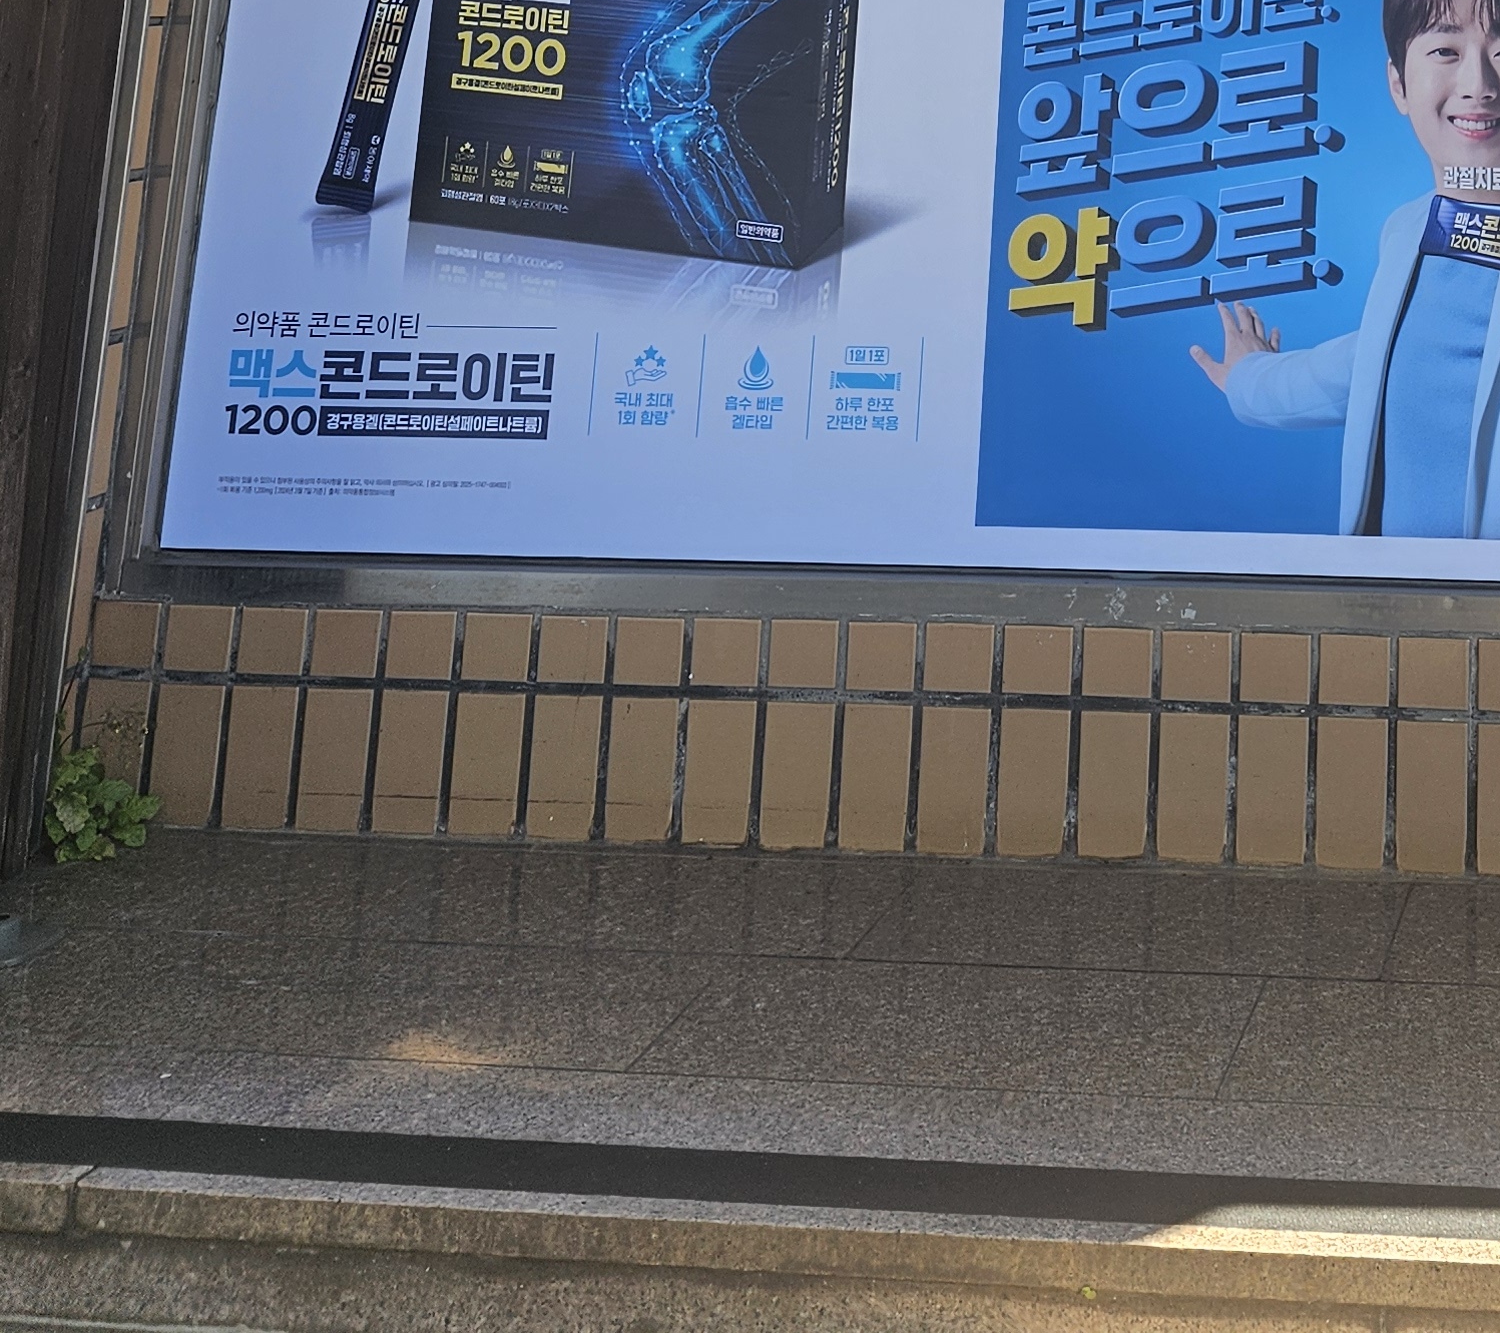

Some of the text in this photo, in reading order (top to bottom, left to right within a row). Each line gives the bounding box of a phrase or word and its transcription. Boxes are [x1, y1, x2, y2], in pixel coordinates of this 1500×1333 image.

[458, 0, 570, 35] 콘드로이틴
[457, 30, 567, 77] 1200
[1450, 233, 1480, 253] 1200
[232, 310, 421, 340] 의약품 콘드로이틴
[848, 348, 886, 363] 1일 1포
[228, 348, 556, 403] 맥스콘드로이틴
[614, 391, 674, 409] 국내 최대
[725, 395, 784, 412] 흡수 빠른
[834, 396, 895, 412] 하루 한포
[225, 403, 544, 436] 1200 경구용겔(콘드로이틴설페이트나트륨)
[617, 409, 637, 426] 1회
[731, 413, 774, 430] 겔타입
[826, 413, 900, 432] 간편한 복용
